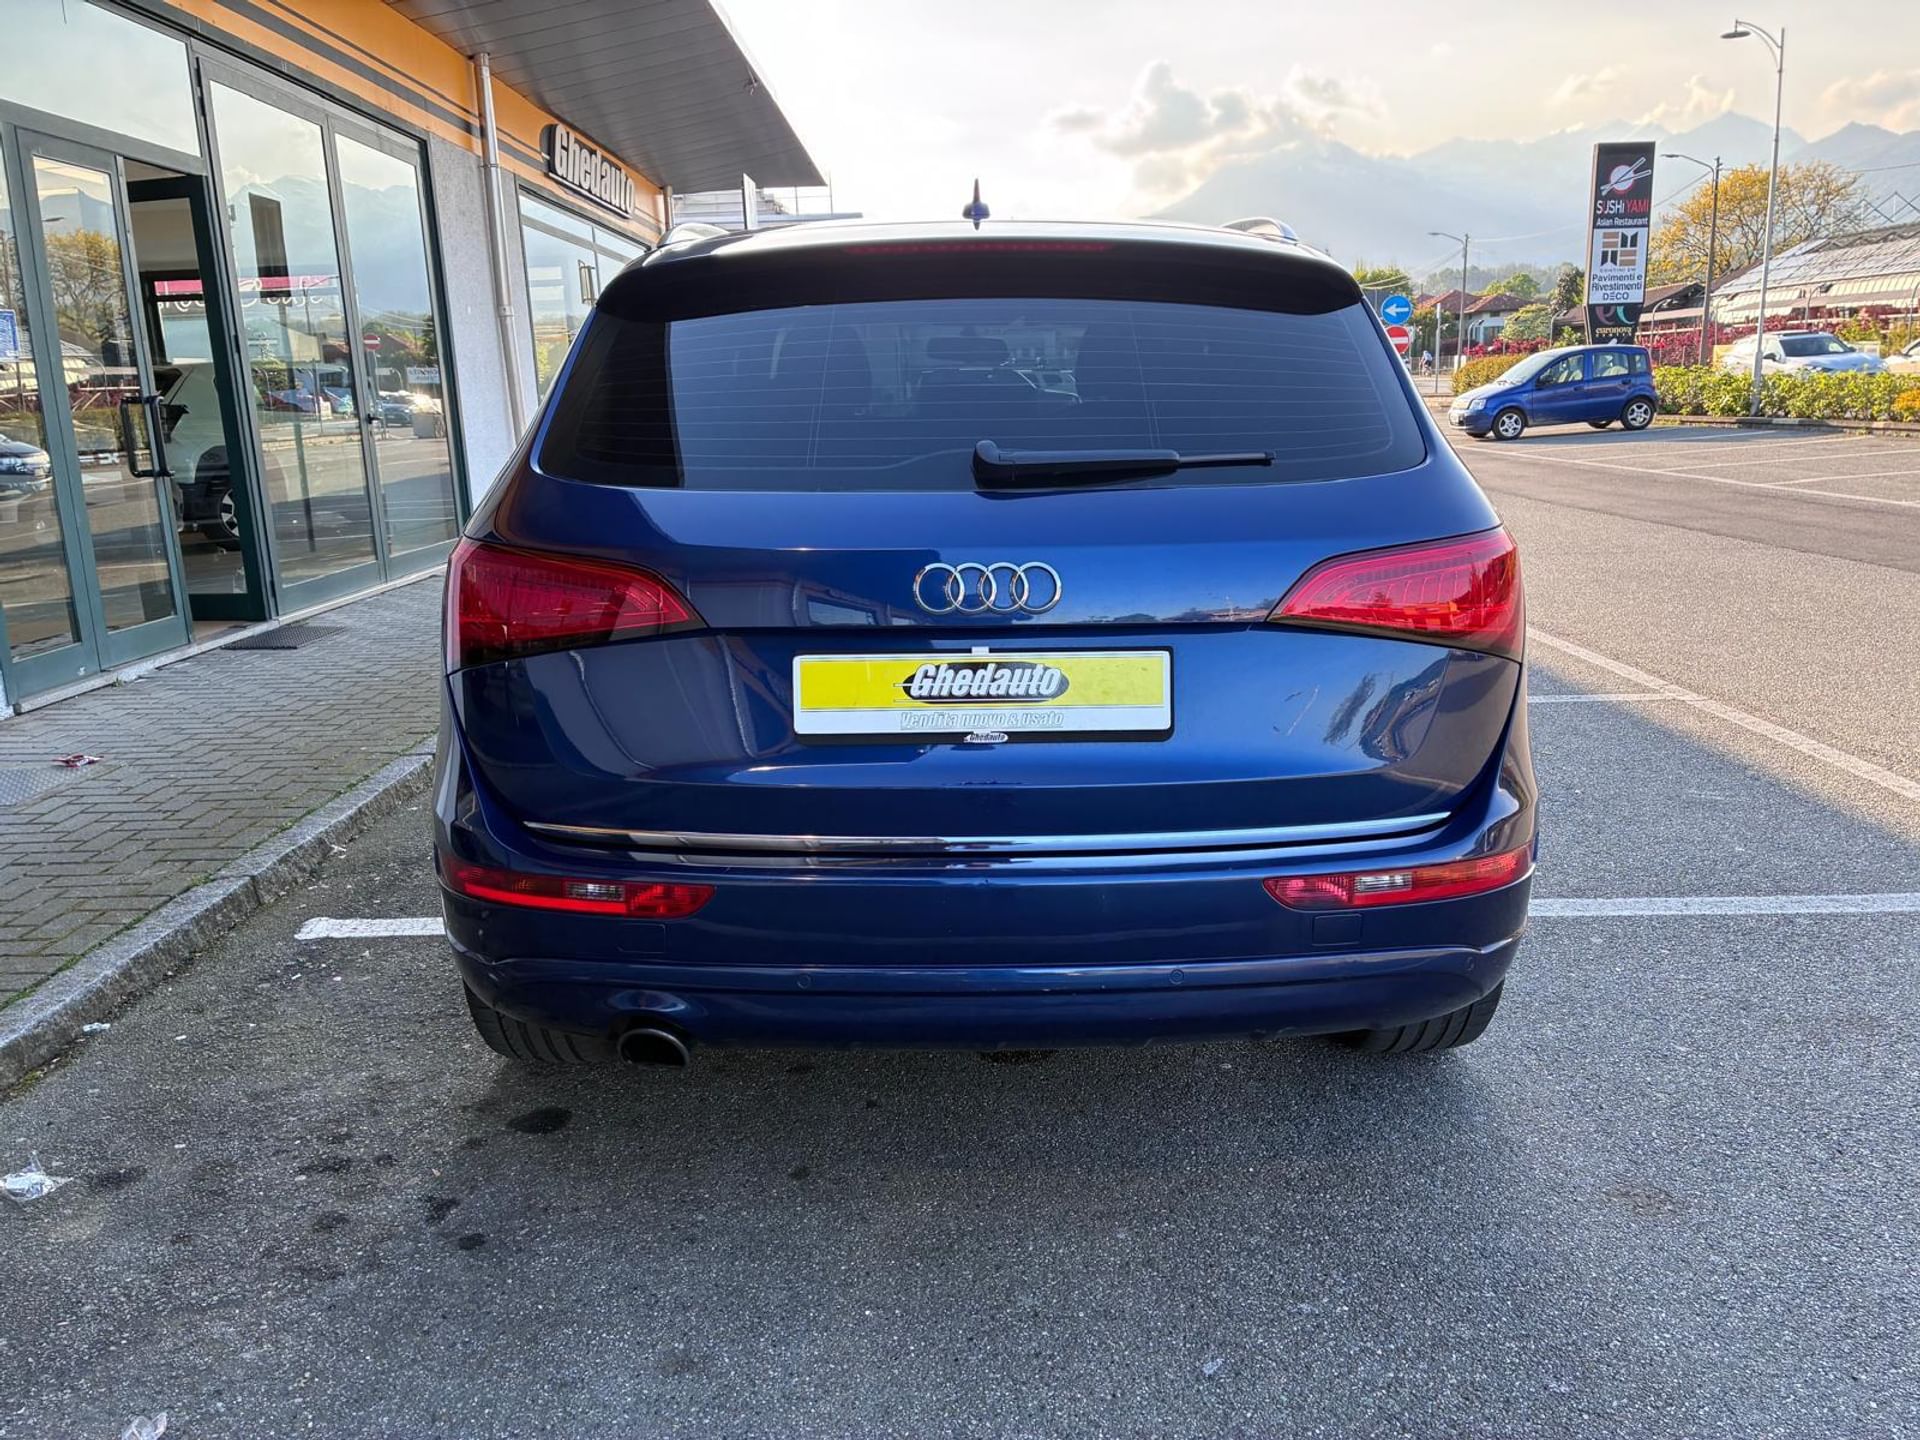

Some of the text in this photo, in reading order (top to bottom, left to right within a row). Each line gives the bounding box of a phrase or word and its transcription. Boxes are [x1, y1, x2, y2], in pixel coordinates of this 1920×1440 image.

[554, 124, 635, 215] Ghedauto
[1626, 199, 1649, 213] YAMI
[1597, 217, 1648, 226] Asian Restaurant
[1592, 273, 1635, 281] Pavimenti
[1591, 282, 1642, 291] Rivestimenti
[909, 663, 1061, 697] Ghedauto
[900, 711, 1064, 730] Vendita nuovo & usato
[969, 732, 1006, 742] Ghedauto
